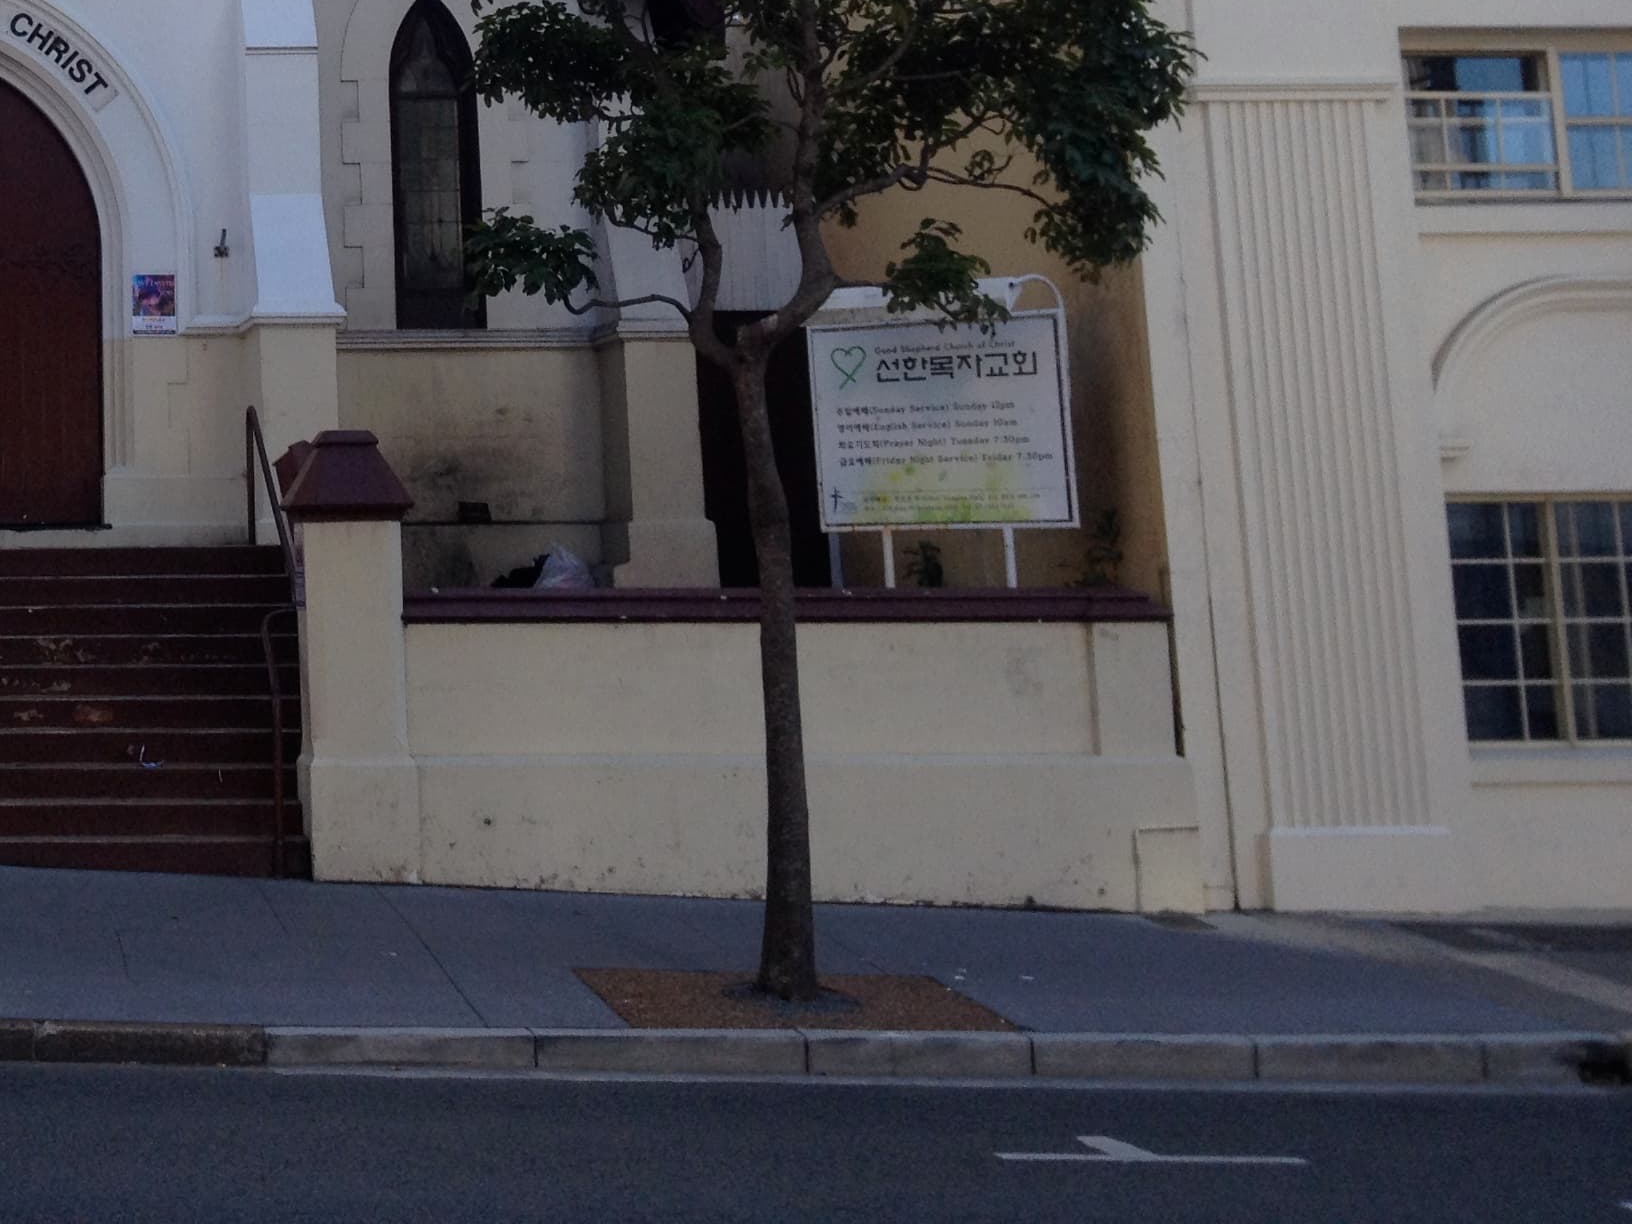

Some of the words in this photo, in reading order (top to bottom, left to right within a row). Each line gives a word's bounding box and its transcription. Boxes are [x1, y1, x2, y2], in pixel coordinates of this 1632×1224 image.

[9, 12, 109, 96] CHRIST
[944, 342, 974, 351] Church
[989, 340, 1016, 349] Christ
[876, 350, 1038, 382] 선한목자교회
